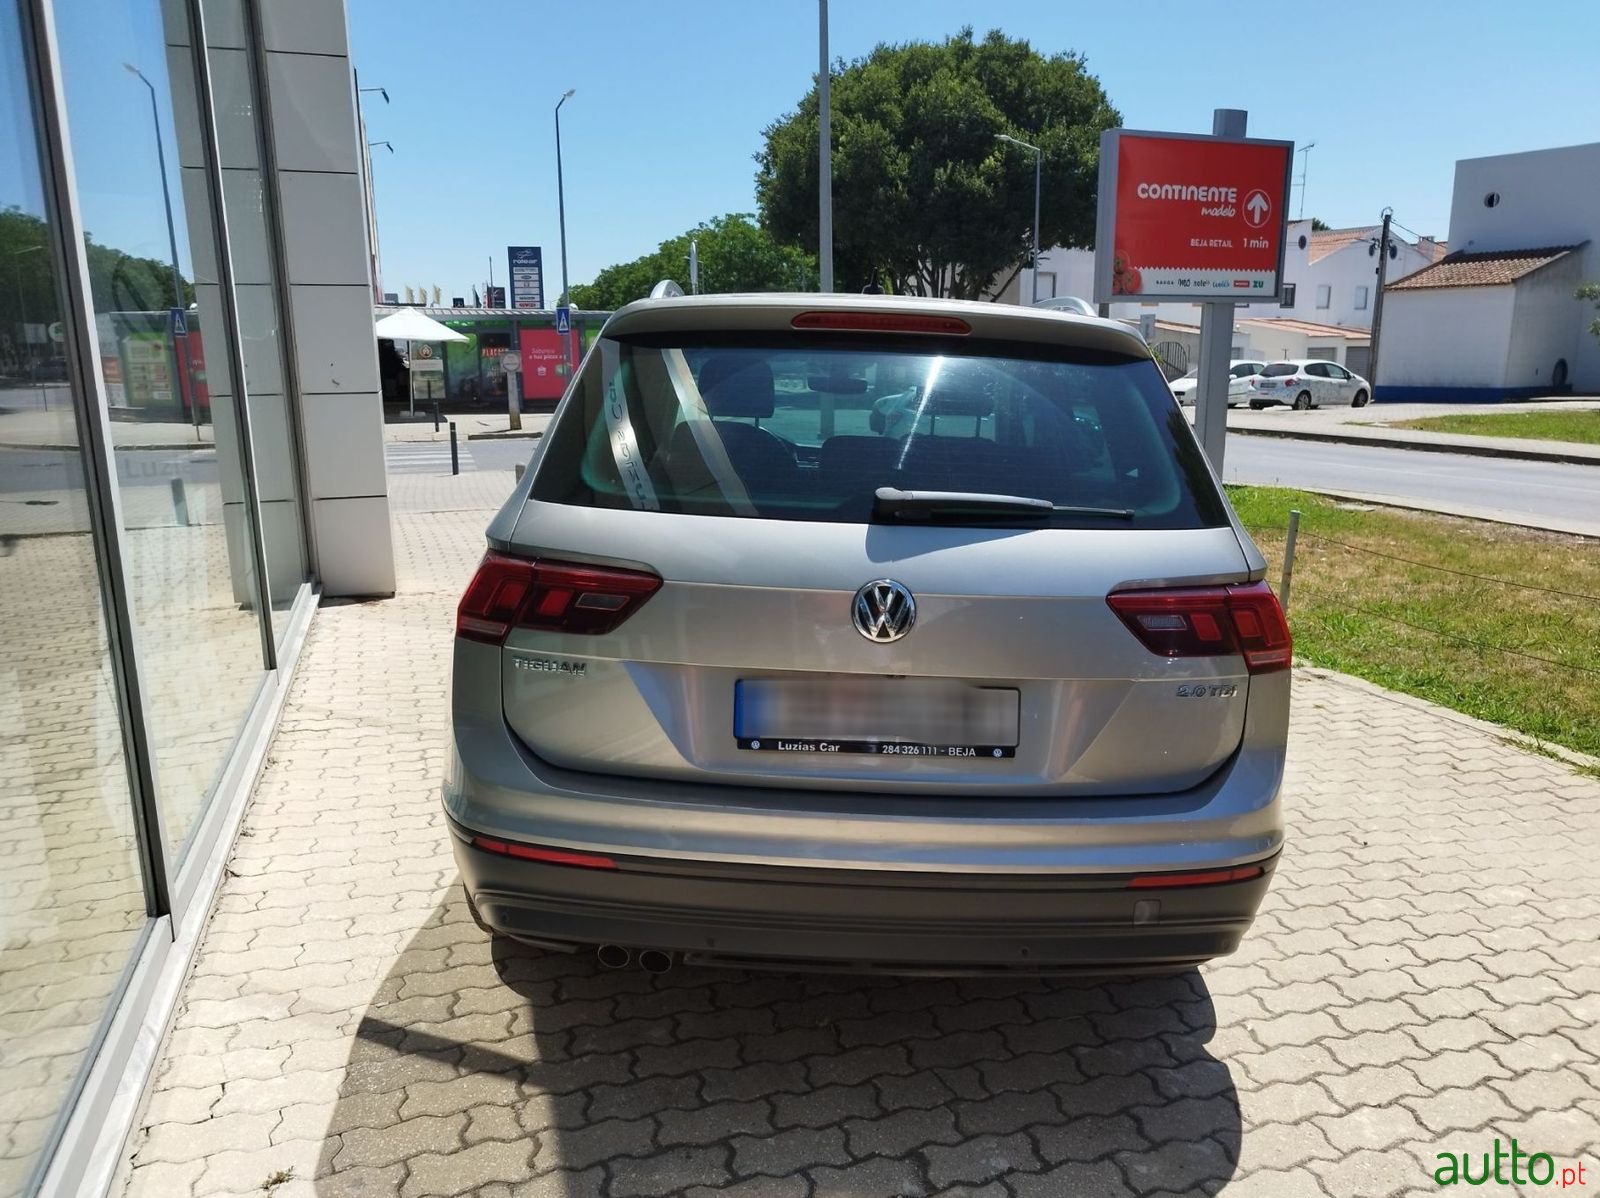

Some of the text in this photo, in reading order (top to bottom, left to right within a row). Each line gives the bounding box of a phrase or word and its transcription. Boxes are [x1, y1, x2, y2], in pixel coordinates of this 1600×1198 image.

[1137, 183, 1238, 203] CONTINENTE
[1201, 204, 1236, 217] modelo
[1190, 238, 1233, 248] BEJA RETAIL
[1243, 237, 1269, 249] 1 min
[512, 655, 587, 677] TIGUAN
[1176, 684, 1238, 698] 2.0 TDI
[777, 741, 841, 753] Luzias Car
[882, 745, 901, 755] 284
[902, 745, 920, 755] 326
[921, 745, 938, 755] 111
[948, 746, 976, 757] BEJA
